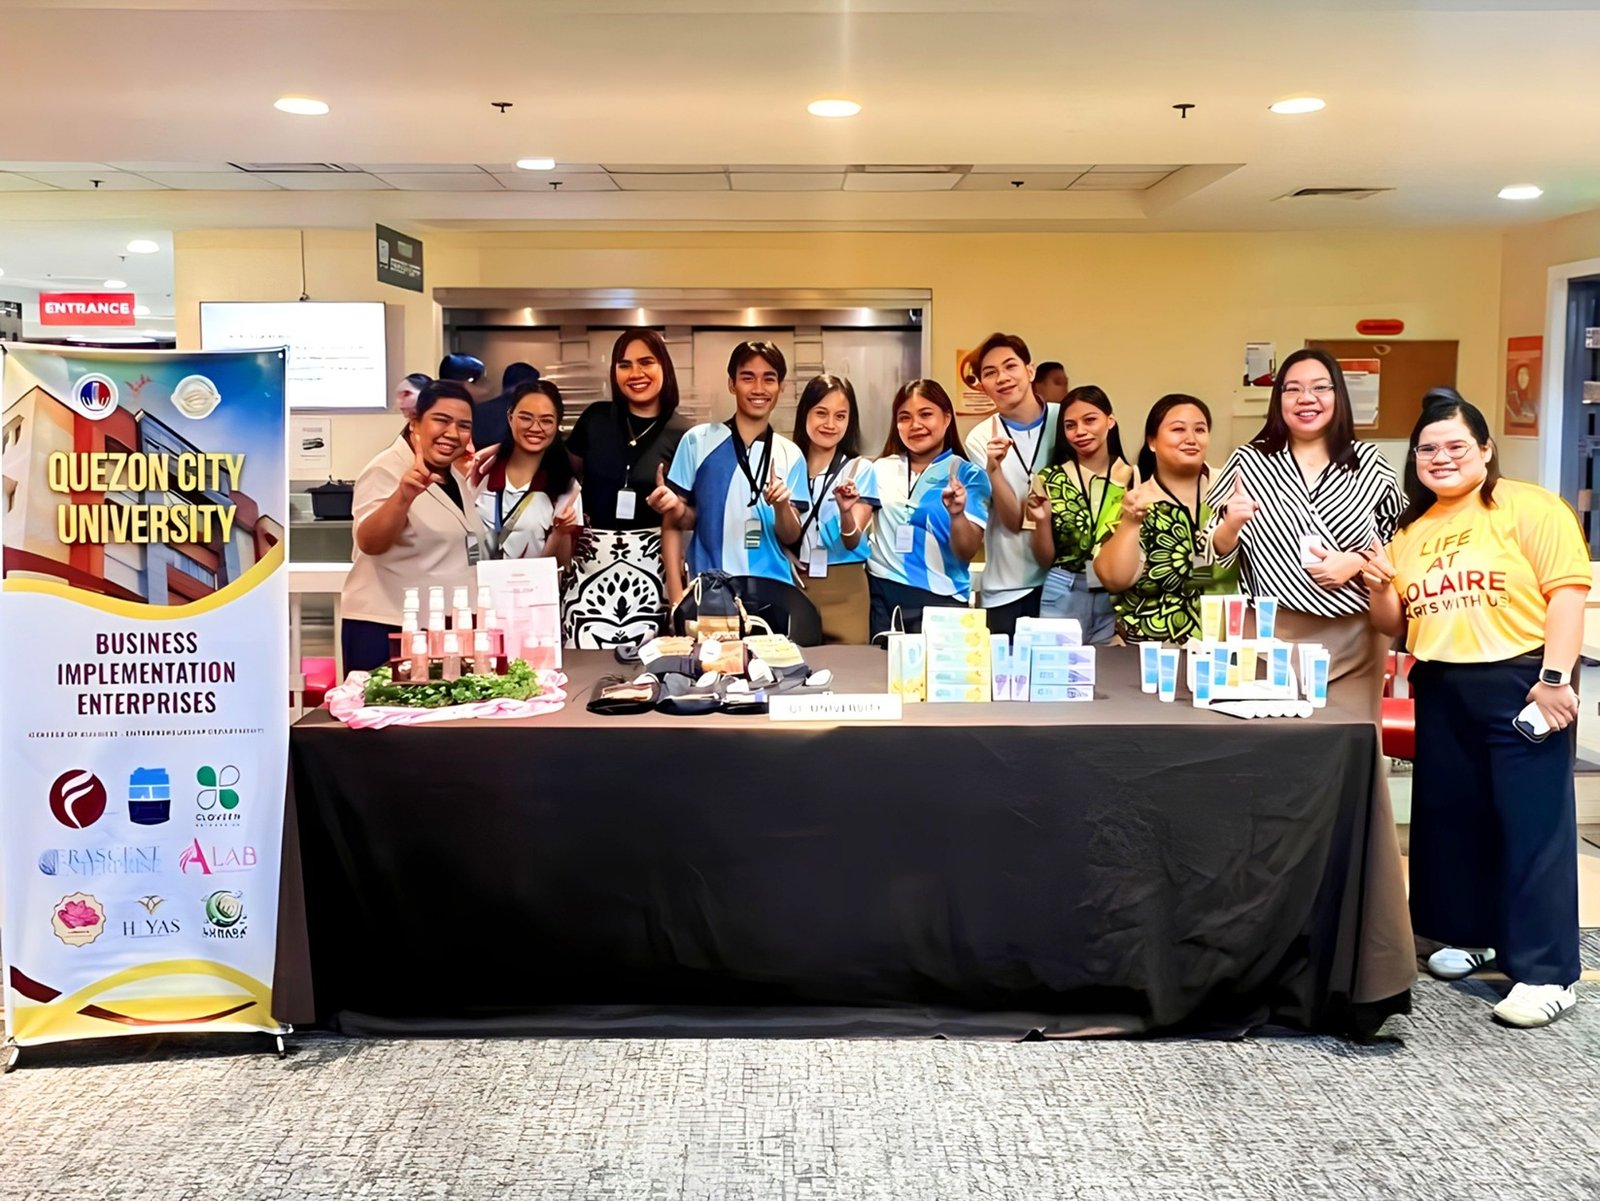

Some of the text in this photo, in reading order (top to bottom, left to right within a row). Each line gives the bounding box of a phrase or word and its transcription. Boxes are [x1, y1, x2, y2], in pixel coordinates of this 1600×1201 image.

[44, 302, 130, 314] ENTRANCE
[48, 452, 246, 493] QUEZON CITY
[57, 504, 237, 544] UNIVERSITY
[1419, 529, 1473, 557] LIFE
[1426, 550, 1460, 573] AT
[1402, 570, 1507, 606] OLAIRE
[1442, 594, 1481, 611] WITH
[96, 631, 198, 655] BUSINESS
[57, 661, 236, 685] IMPLEMENTATION
[77, 691, 217, 715] ENTERPRISES
